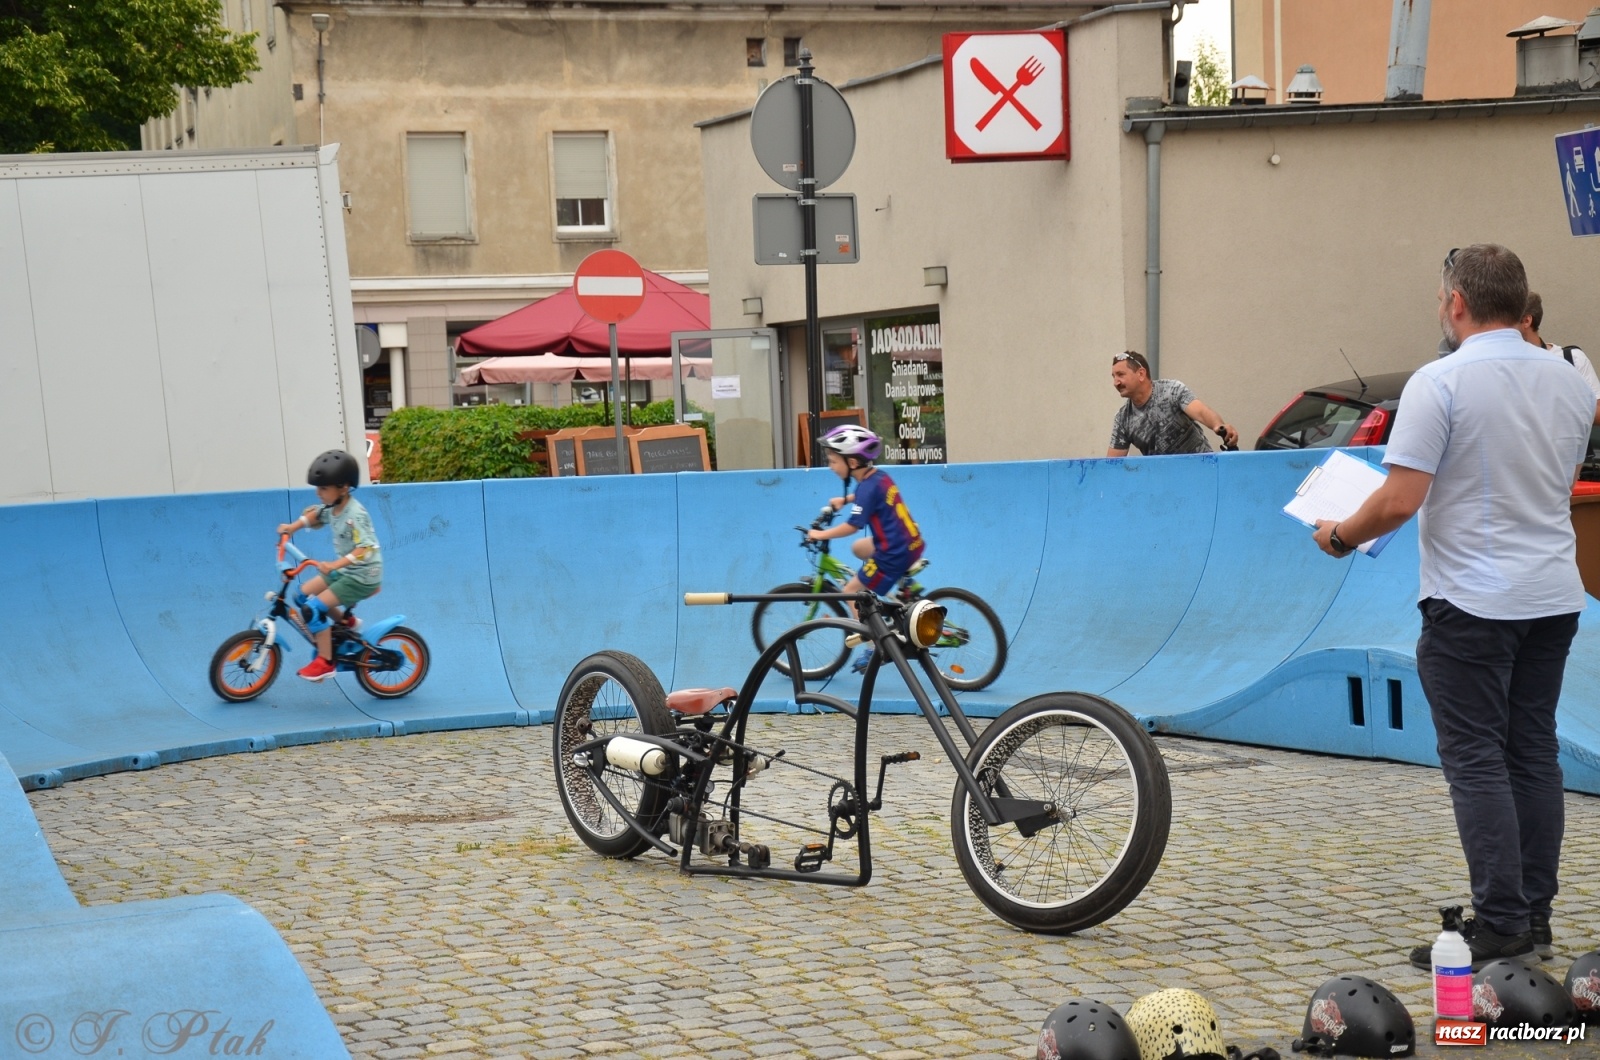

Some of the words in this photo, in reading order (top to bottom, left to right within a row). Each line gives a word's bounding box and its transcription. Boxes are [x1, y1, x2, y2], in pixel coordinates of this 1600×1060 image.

[871, 323, 942, 355] JADŁODAJNI
[892, 357, 928, 377] Śniadania
[885, 382, 906, 398] Dania
[908, 381, 936, 397] barowe
[901, 402, 921, 422] Zupy
[899, 423, 926, 443] Obiady
[885, 445, 906, 460] Dania
[907, 449, 917, 460] na
[917, 447, 943, 464] wynos
